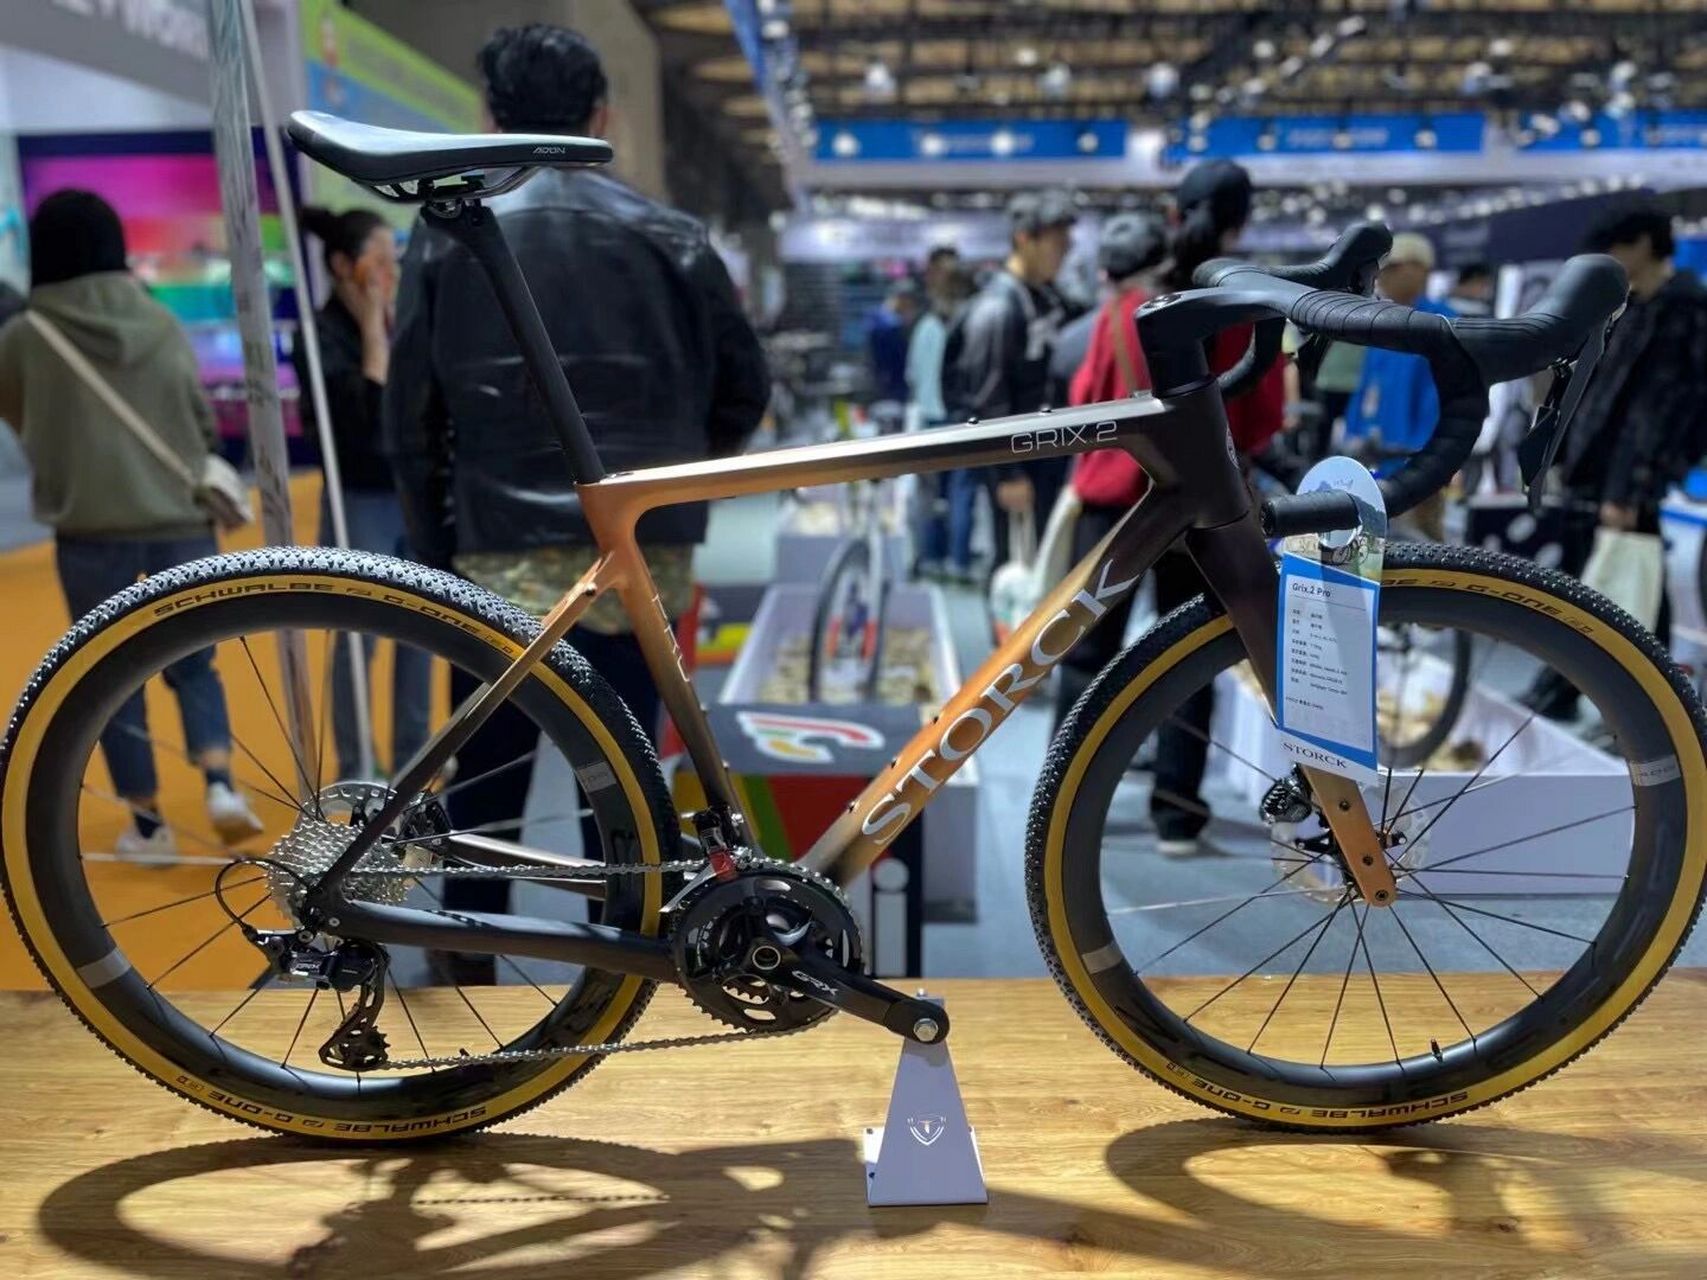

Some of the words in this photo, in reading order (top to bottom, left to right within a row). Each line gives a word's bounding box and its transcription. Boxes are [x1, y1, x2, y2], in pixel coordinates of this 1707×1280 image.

[1317, 587, 1331, 598] Pro
[1466, 583, 1564, 615] G-ONE
[153, 582, 335, 617] SCHWALBE
[383, 594, 482, 635] G-ONE
[862, 558, 1140, 846] STORCK
[1282, 742, 1347, 769] STORCK
[791, 970, 839, 996] GRX
[208, 1090, 294, 1123] G-ONE
[1192, 1078, 1272, 1111] G-ONE
[1311, 1091, 1469, 1119] SCHWALBE
[334, 1105, 487, 1133] SCHWALBE
